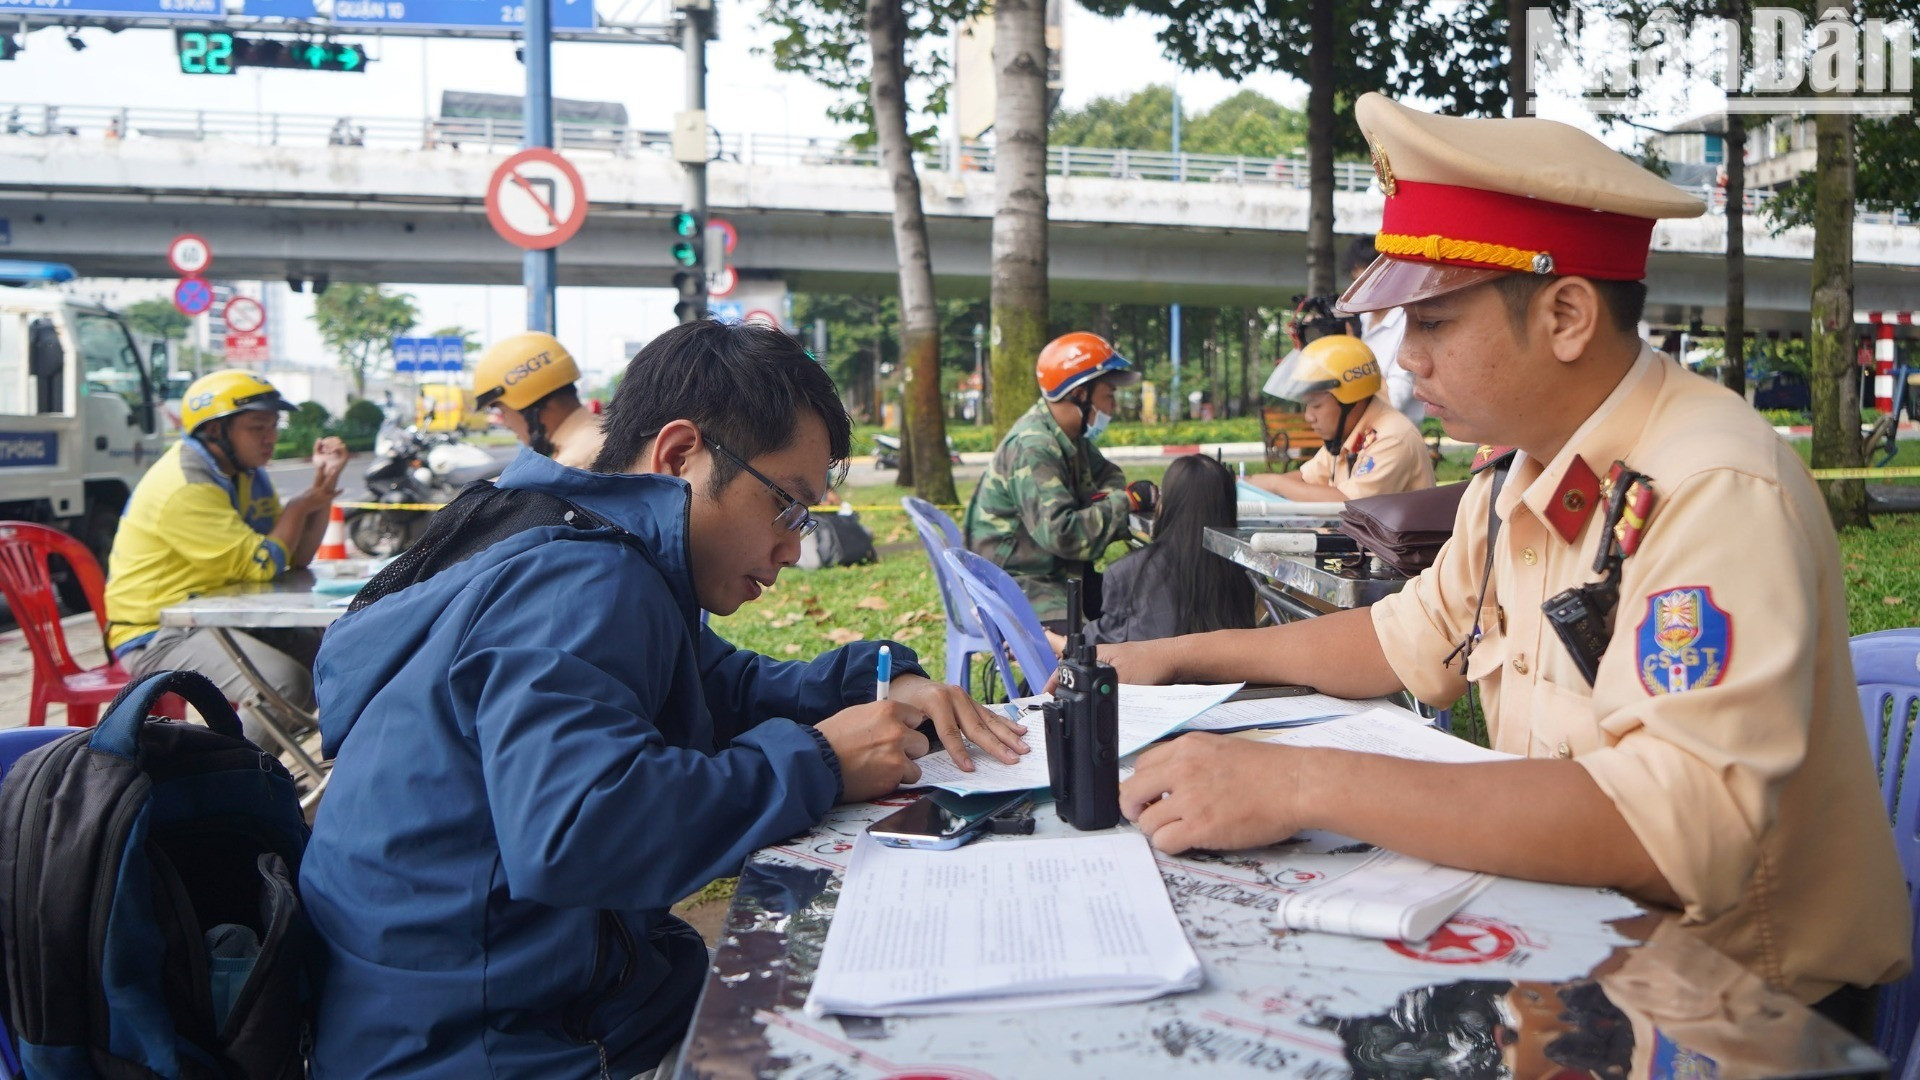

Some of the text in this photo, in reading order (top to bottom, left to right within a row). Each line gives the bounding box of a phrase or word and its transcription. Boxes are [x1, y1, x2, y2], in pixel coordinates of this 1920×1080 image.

[181, 32, 233, 74] 22
[504, 351, 552, 386] CSGT
[1342, 360, 1379, 382] CSGT
[189, 393, 214, 411] be
[1643, 647, 1719, 673] CSGT
